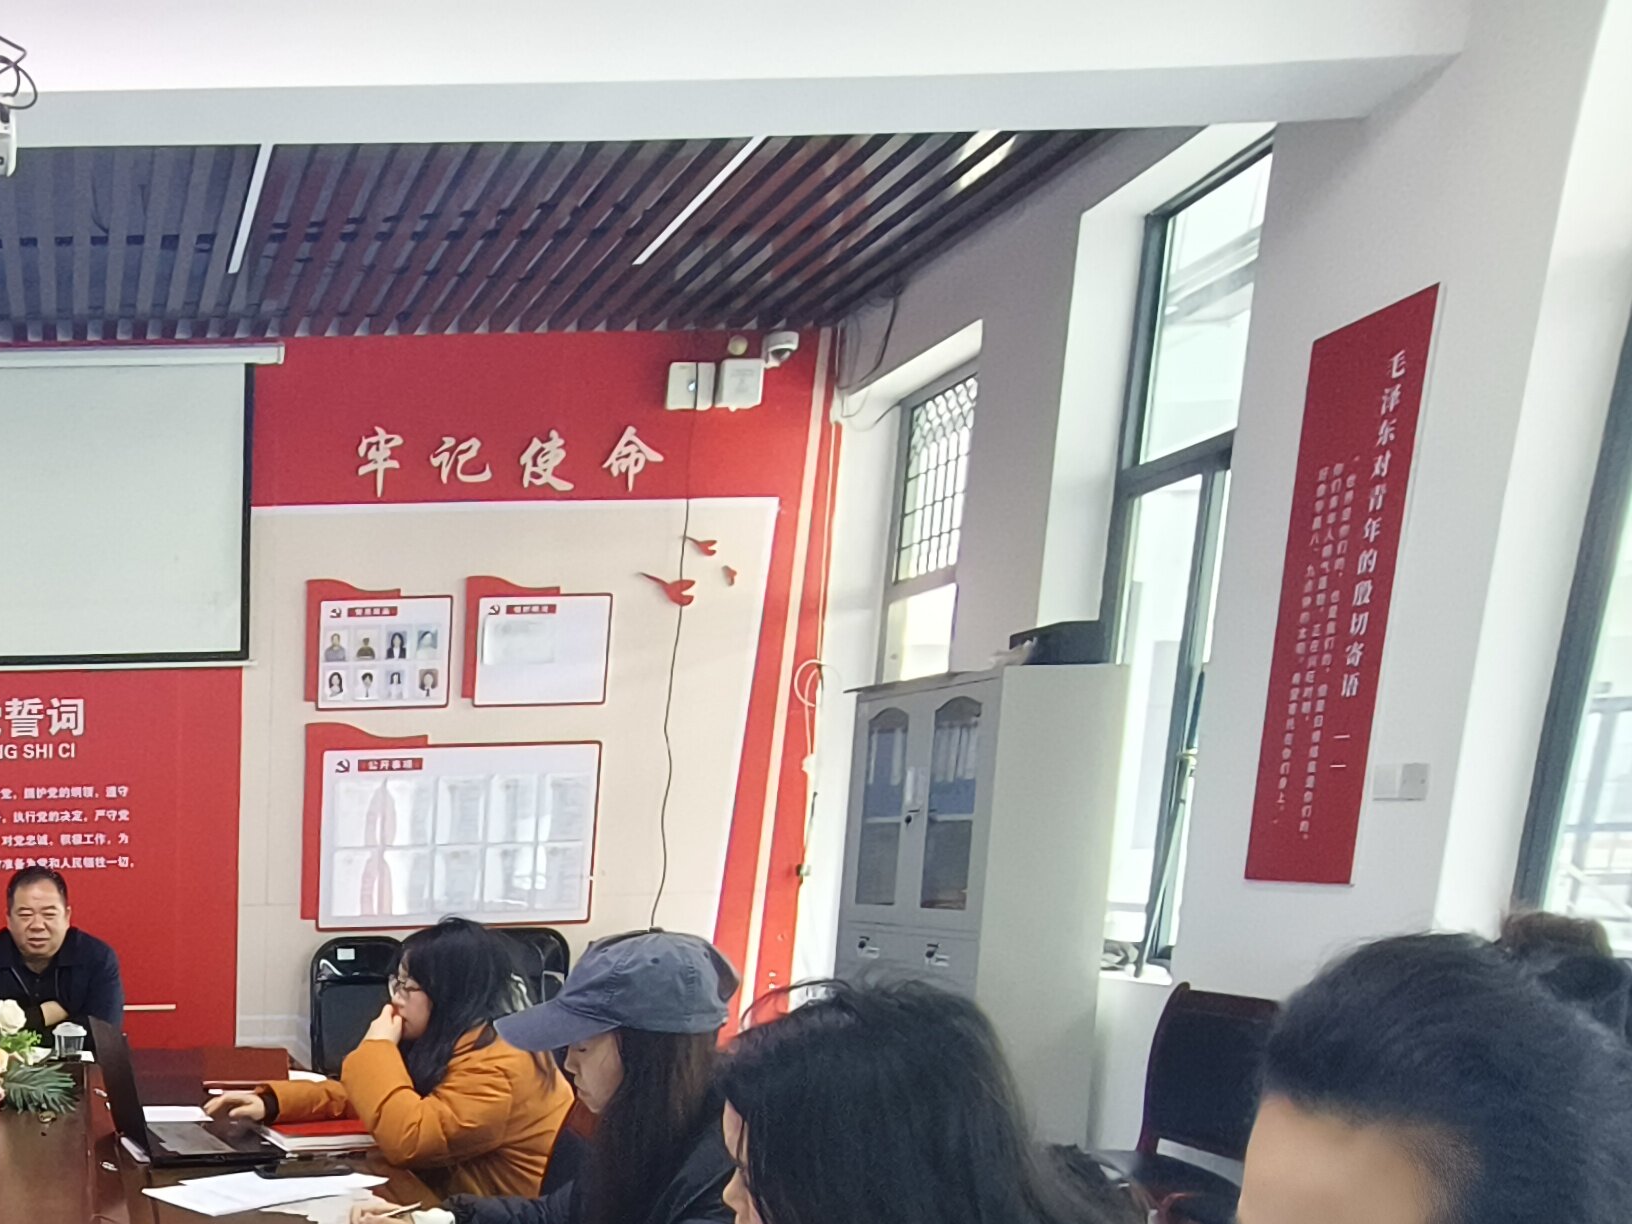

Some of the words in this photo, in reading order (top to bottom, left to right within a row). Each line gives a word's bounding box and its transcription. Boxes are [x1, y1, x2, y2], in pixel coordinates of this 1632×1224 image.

[356, 425, 664, 498] 牢记使命
[1340, 350, 1408, 698] 毛泽东对青年的殷切寄语
[23, 743, 53, 758] SHI
[58, 742, 76, 758] CI
